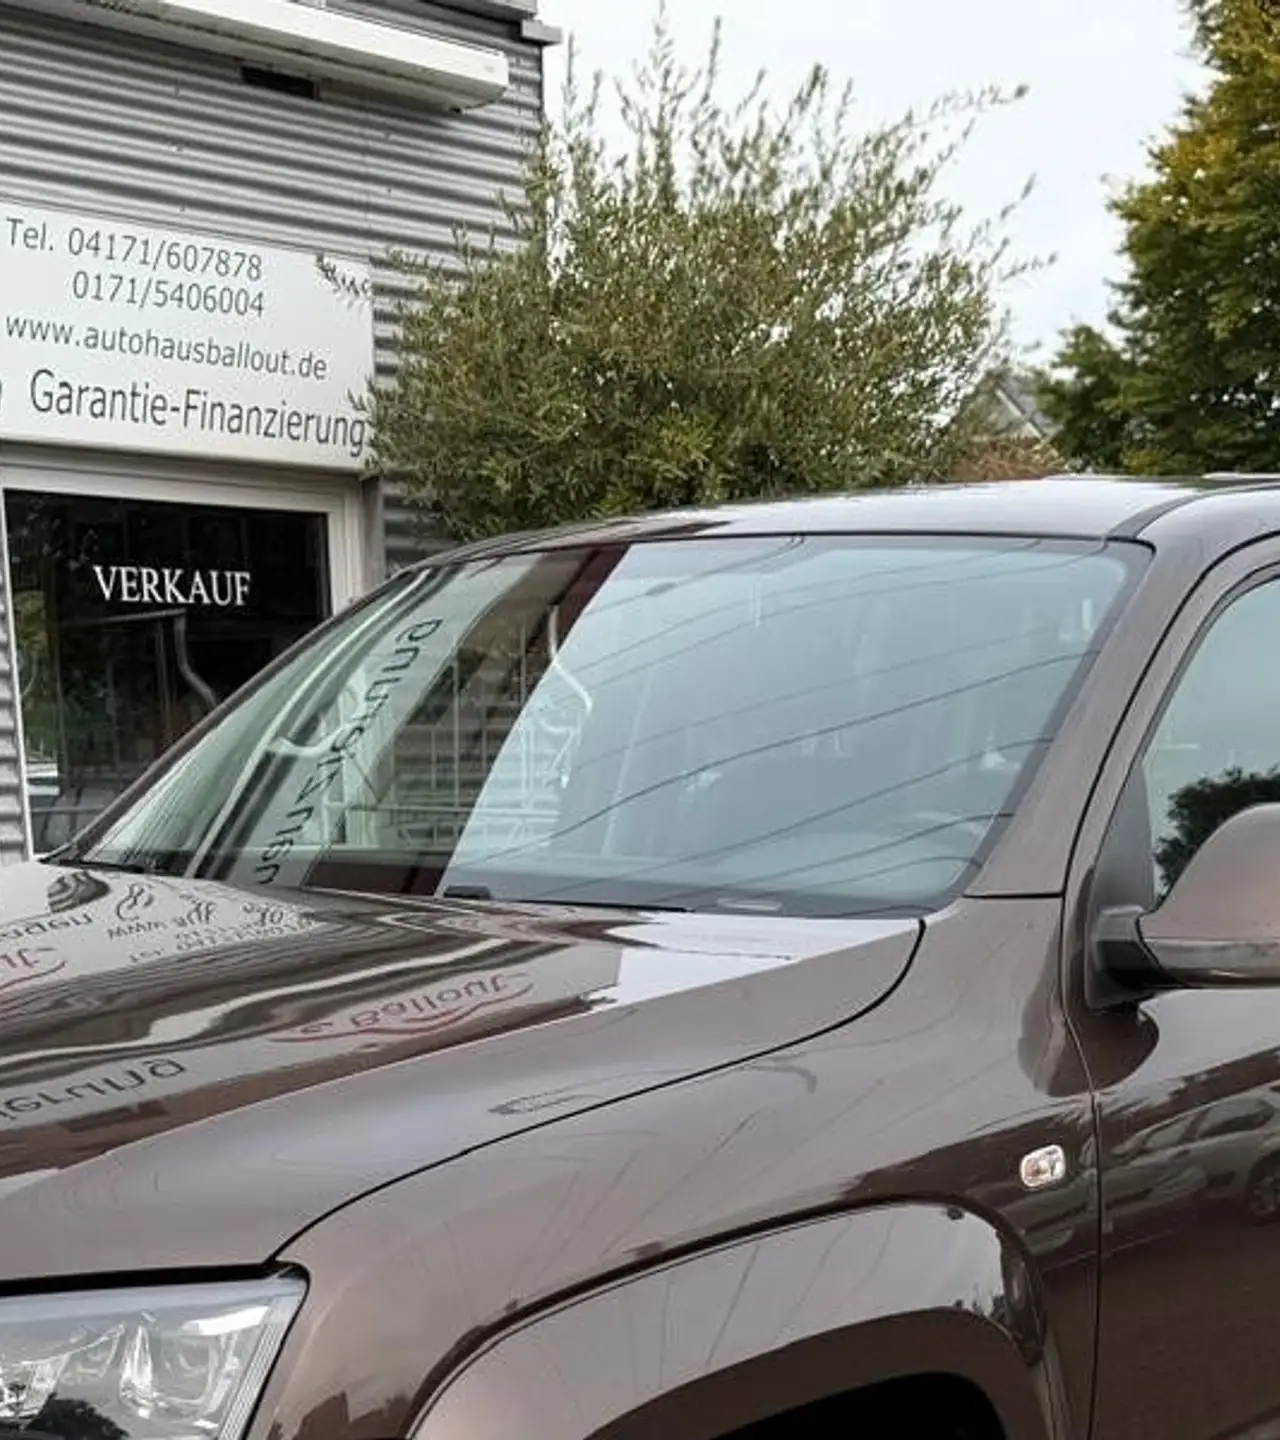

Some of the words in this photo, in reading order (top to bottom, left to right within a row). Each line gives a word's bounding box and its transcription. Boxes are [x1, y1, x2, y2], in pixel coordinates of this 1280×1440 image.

[5, 218, 54, 252] Tel.
[68, 227, 263, 283] 04171/607878
[72, 270, 266, 320] 0171/5406004
[5, 313, 328, 382] www.autohausballout.de
[29, 369, 367, 458] Garantie-Finanzierung
[94, 564, 251, 607] VERKAUF
